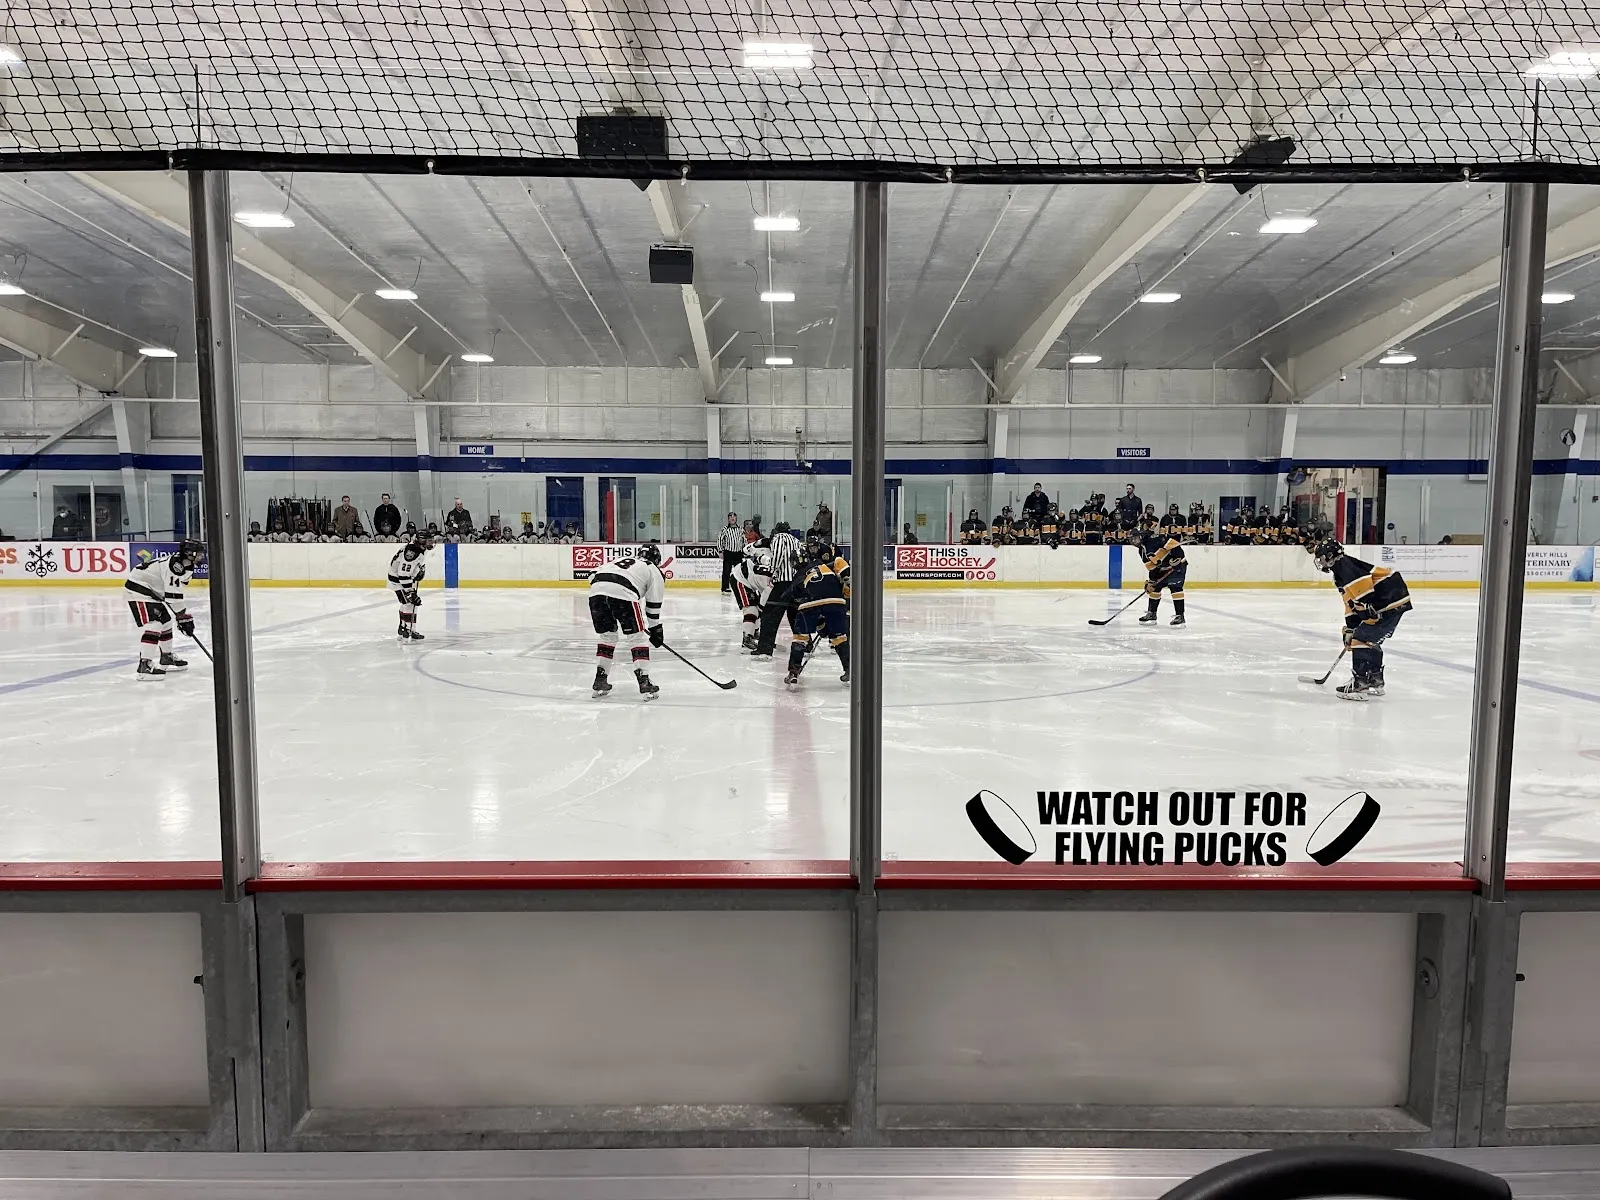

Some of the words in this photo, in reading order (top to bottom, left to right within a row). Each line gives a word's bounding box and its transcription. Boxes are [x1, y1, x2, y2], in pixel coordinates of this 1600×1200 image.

[467, 446, 486, 454] HOME
[1120, 448, 1147, 456] VISITORS
[604, 547, 632, 557] THIS
[928, 547, 955, 557] THIS
[957, 547, 968, 557] IS
[62, 547, 127, 573] UBS
[930, 557, 982, 567] HOCKEY.
[169, 576, 180, 587] 14
[1037, 791, 1159, 826] WATCH
[1168, 791, 1236, 826] OUT
[1244, 791, 1307, 827] FOR
[1055, 831, 1164, 866] FLYING
[1174, 831, 1287, 866] PUCKS
